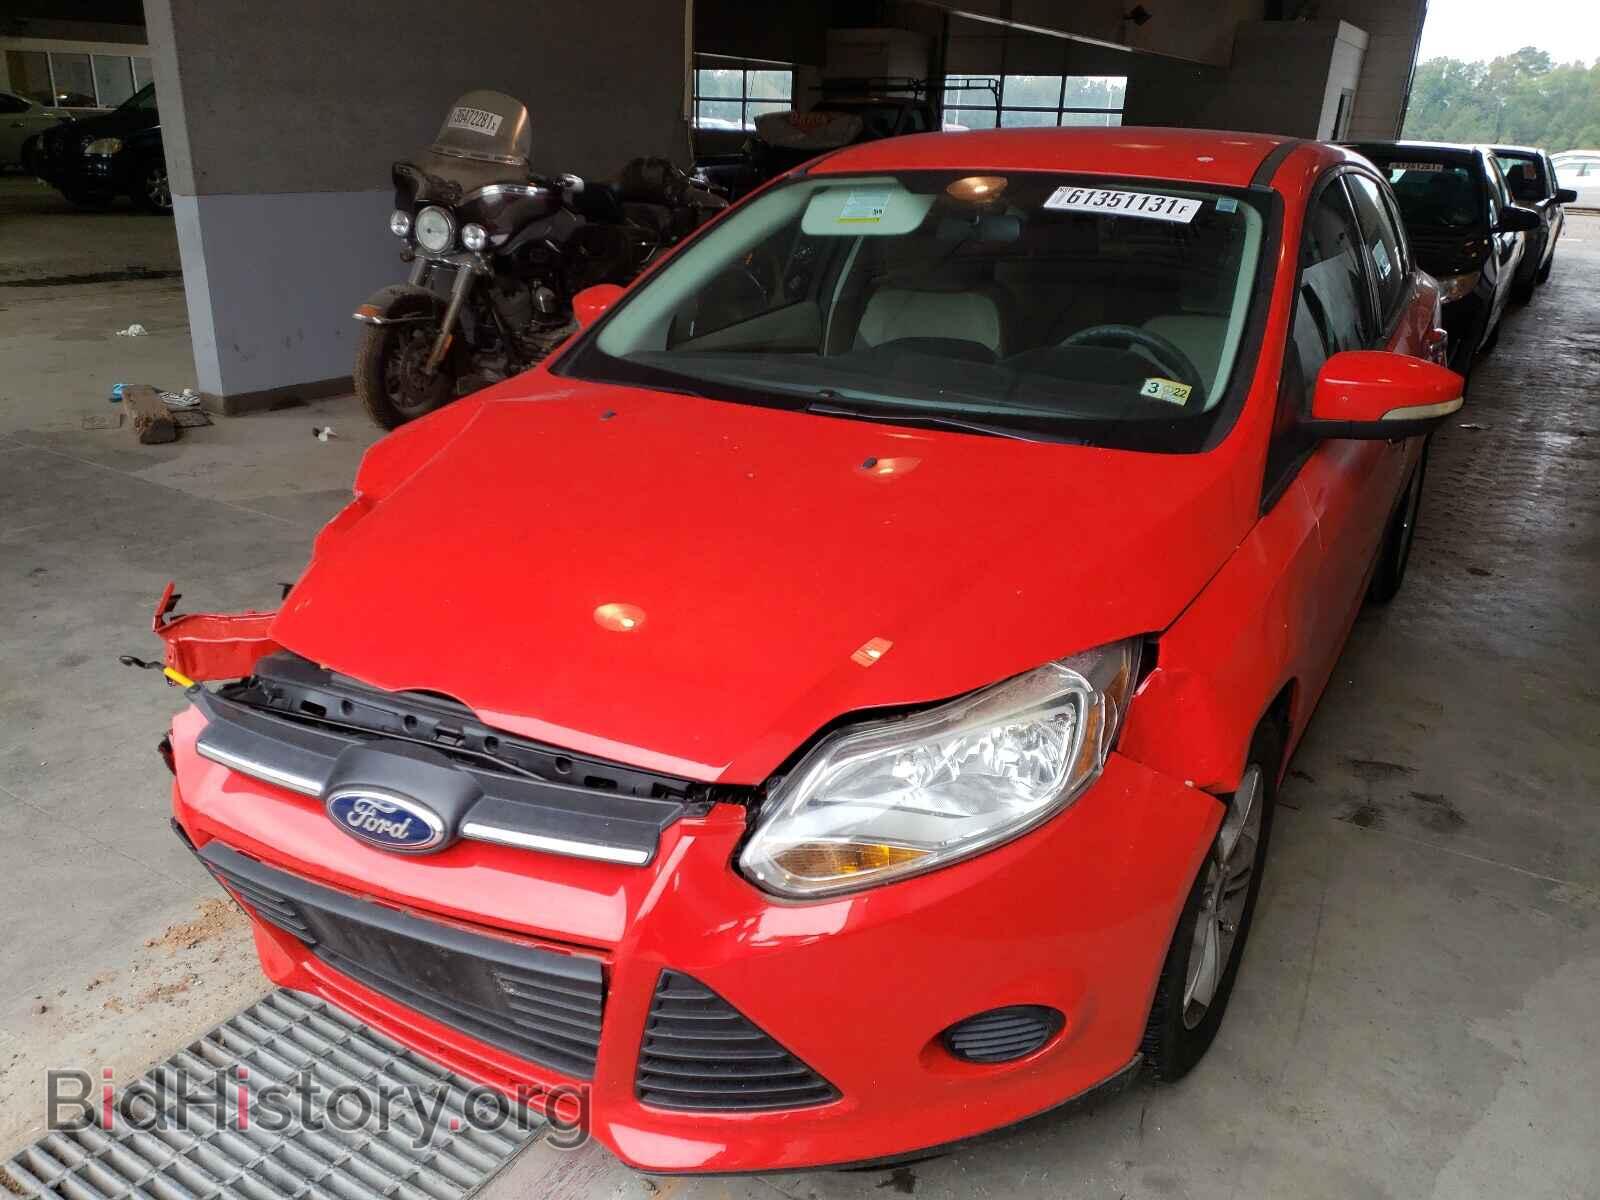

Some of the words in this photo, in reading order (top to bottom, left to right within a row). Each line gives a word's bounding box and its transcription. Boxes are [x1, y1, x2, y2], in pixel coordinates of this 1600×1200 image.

[1147, 382, 1160, 394] 3
[1173, 387, 1188, 399] 22
[347, 798, 412, 839] Ford
